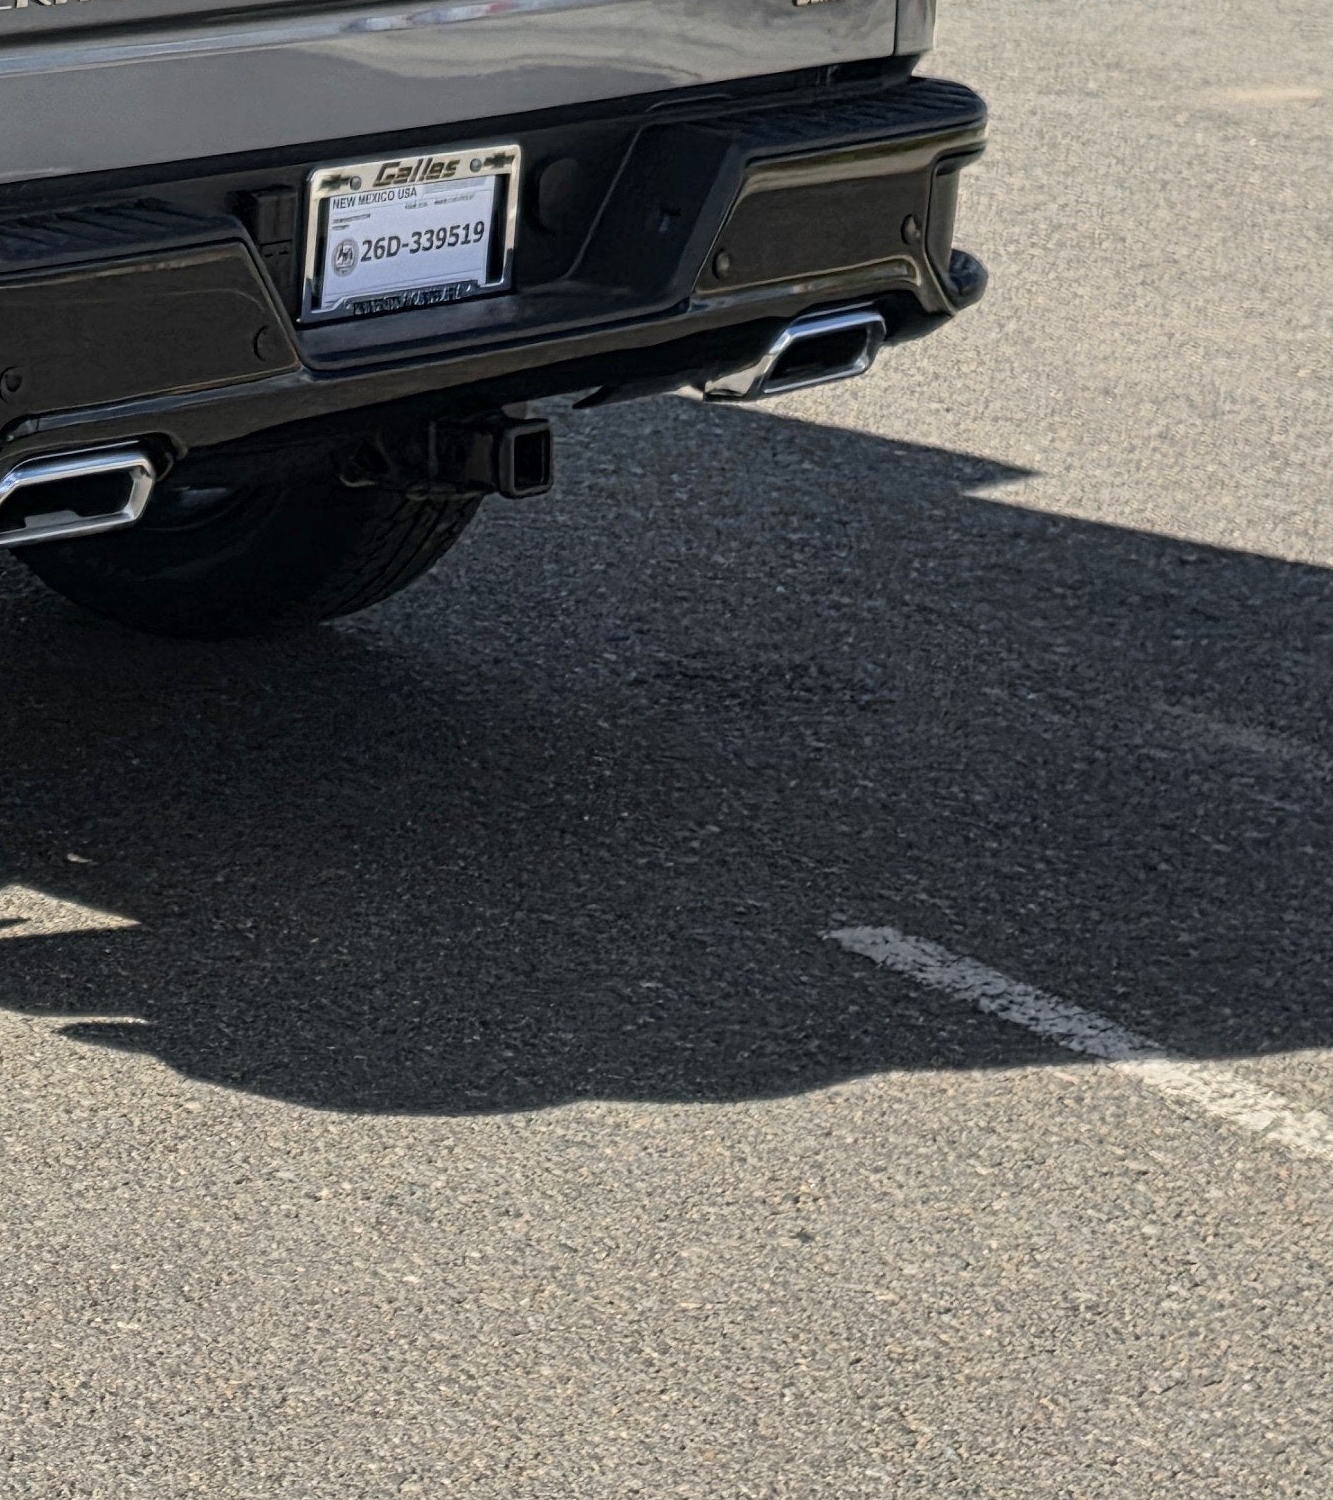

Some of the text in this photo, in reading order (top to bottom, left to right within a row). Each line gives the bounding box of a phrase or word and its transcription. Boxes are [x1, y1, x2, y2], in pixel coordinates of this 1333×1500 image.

[372, 156, 461, 188] Galles
[332, 196, 355, 210] NEW
[358, 189, 395, 206] MEXICO
[396, 186, 418, 200] USA
[359, 220, 486, 263] 26D-339519
